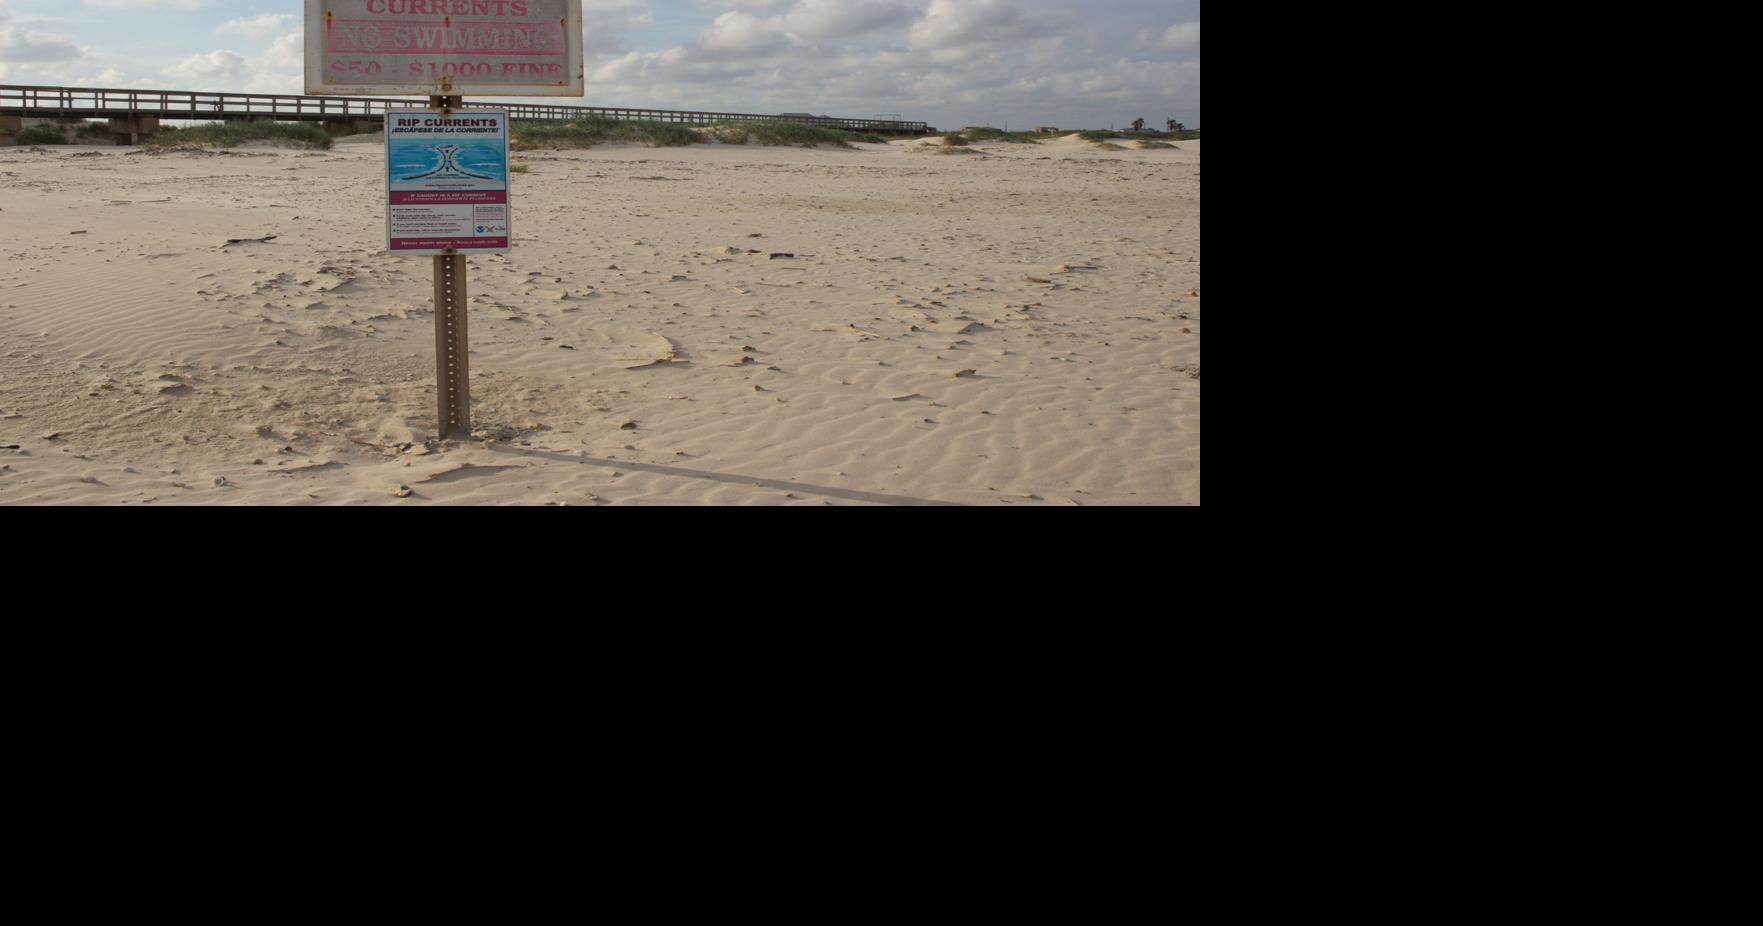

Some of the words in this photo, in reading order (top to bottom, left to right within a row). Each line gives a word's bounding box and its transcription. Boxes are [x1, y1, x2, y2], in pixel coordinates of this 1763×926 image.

[367, 0, 528, 17] CURRENTS
[341, 26, 382, 48] NO
[394, 27, 552, 49] SWIMMING
[331, 60, 382, 76] $50
[408, 61, 493, 78] $1000
[501, 62, 562, 79] FINE
[398, 118, 420, 127] RIP
[424, 118, 497, 127] CURRENTS
